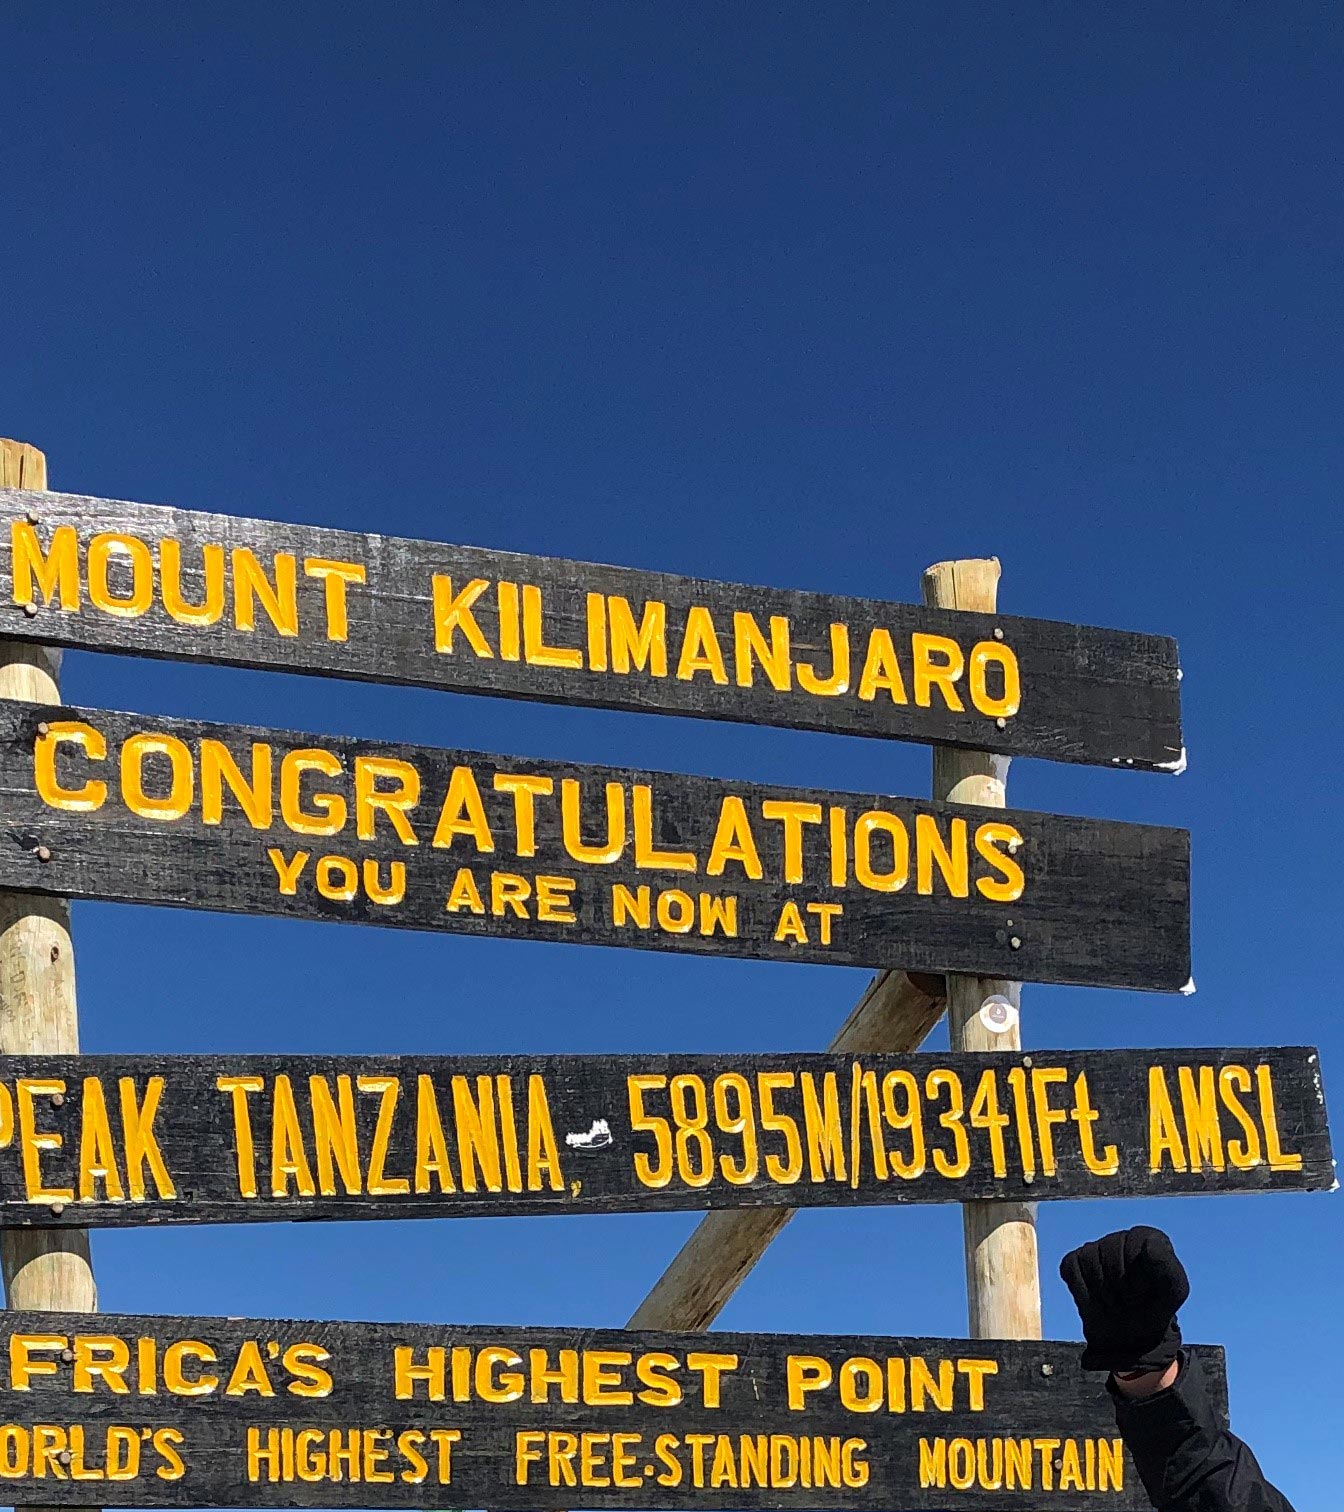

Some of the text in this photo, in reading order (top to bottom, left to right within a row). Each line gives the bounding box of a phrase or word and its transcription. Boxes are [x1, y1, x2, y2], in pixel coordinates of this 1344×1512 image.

[11, 521, 1020, 719] MOUNT KILIMANJARO
[34, 721, 1025, 902] CONGRATULATIONS
[269, 849, 841, 943] YOU ARE NOW AT
[627, 1065, 1118, 1186] 5895M/19341Ft
[1149, 1065, 1300, 1172] AMSL
[394, 1346, 738, 1408] HIGHEST
[787, 1355, 998, 1413] POINT
[248, 1427, 461, 1484] HIGHEST
[919, 1438, 1123, 1490] MOUNTAIN
